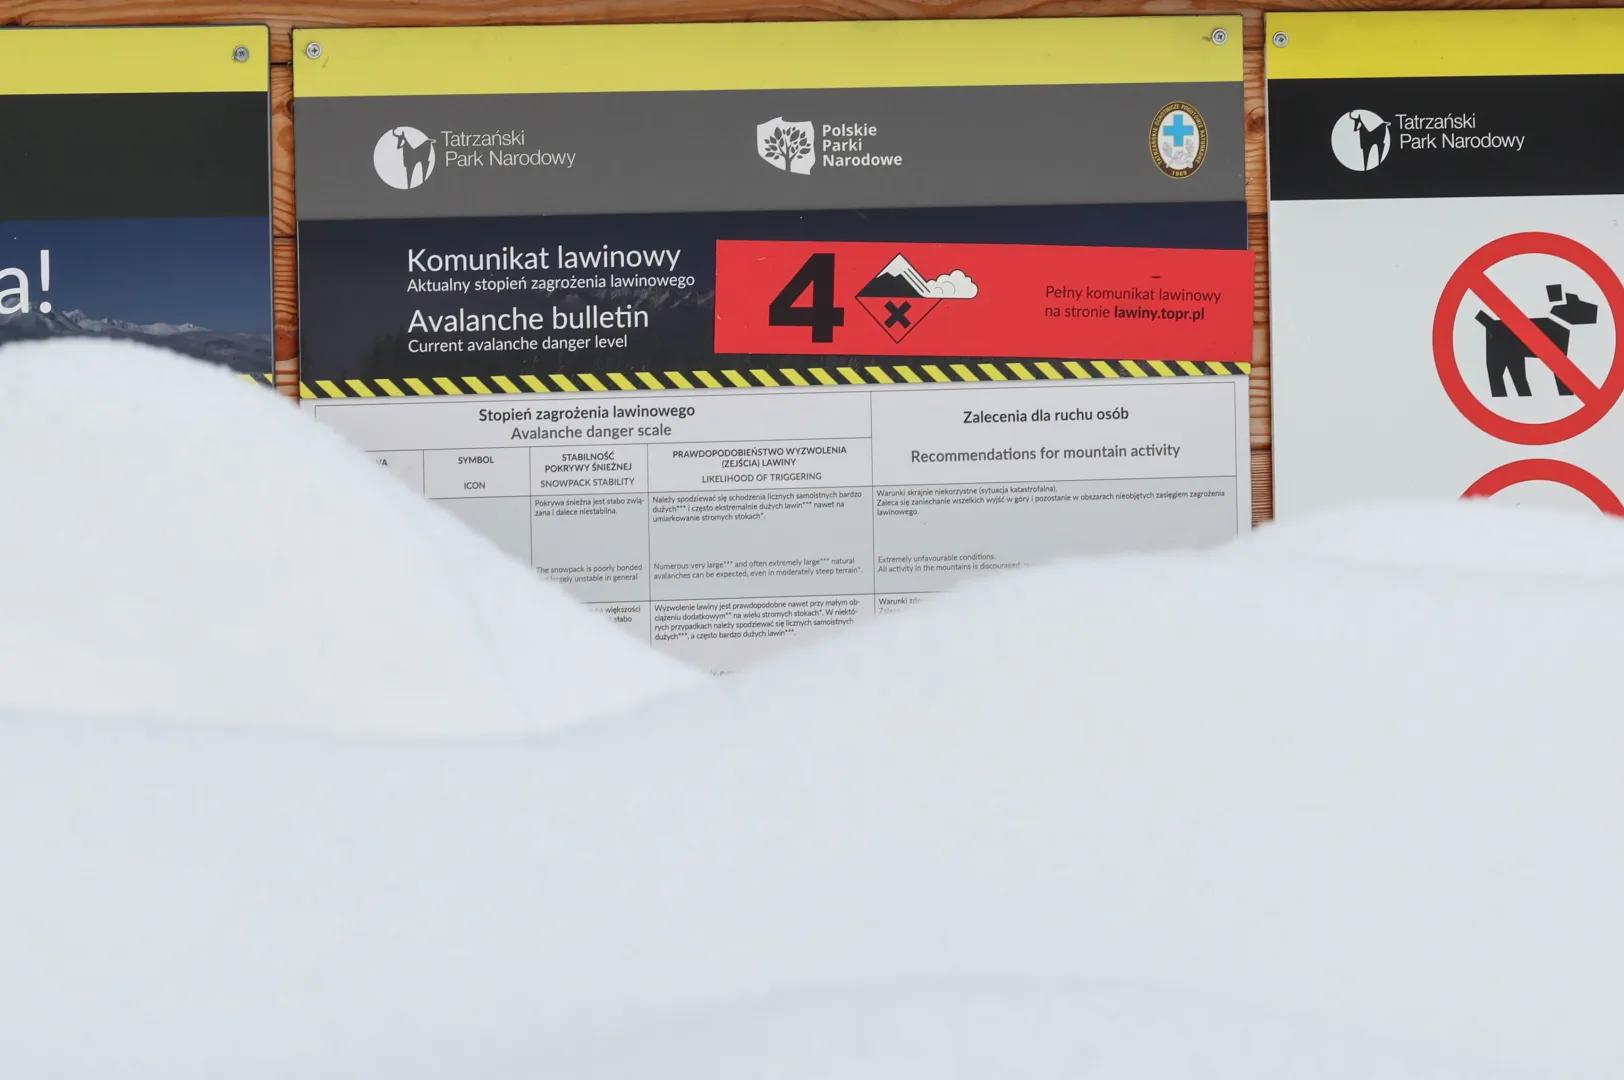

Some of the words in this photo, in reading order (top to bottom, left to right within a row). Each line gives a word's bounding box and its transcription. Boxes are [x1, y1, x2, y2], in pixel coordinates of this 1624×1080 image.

[1394, 113, 1475, 130] Tatrzański
[822, 124, 877, 136] Polskie
[440, 129, 524, 146] Tatrzański
[1400, 133, 1437, 149] Park
[1442, 132, 1525, 149] Narodowy
[822, 138, 862, 151] Parki
[445, 150, 483, 166] Park
[489, 149, 576, 167] Narodowy
[823, 153, 902, 166] Narodowe
[408, 246, 549, 272] Komunikat
[558, 244, 680, 271] lawinowy
[406, 277, 470, 293] Aktualny
[474, 276, 526, 292] stopień
[531, 275, 606, 292] zagrożenia
[610, 274, 695, 289] lawinowego
[768, 253, 844, 343] 4
[1046, 285, 1083, 301] Pełny
[1086, 286, 1155, 300] komunikat
[1159, 287, 1221, 304] lawinowy
[407, 306, 543, 333] Avalanche
[552, 304, 648, 329] bulletin
[1045, 307, 1060, 317] na
[1064, 305, 1110, 317] stronie
[1114, 305, 1204, 322] lawiny.topr.pl
[408, 339, 463, 352] Current
[467, 336, 538, 351] avalanche
[541, 336, 591, 351] danger
[595, 334, 627, 348] level
[479, 407, 531, 423] Stopień
[535, 406, 608, 422] zagrożenia
[613, 405, 695, 418] lawinowego
[963, 409, 1027, 423] Zalecenia
[1031, 409, 1050, 421] dla
[1054, 408, 1092, 421] ruchu
[1096, 407, 1129, 420] osób
[510, 425, 582, 440] Avalanche
[586, 424, 634, 440] danger
[637, 423, 671, 436] scale
[561, 450, 614, 463] STABILNOŚĆ
[672, 446, 784, 458] PRAWDOPODOBIEŃSTWO
[785, 446, 847, 455] WYZWOLENIA
[911, 447, 1036, 462] Recommendations
[1039, 446, 1060, 459] for
[1063, 445, 1126, 458] mountain
[1130, 444, 1180, 458] activity
[458, 455, 494, 464] SYMBOL
[721, 458, 760, 468] (ZEJŚCIA)
[761, 458, 796, 466] LAWINY
[544, 464, 590, 472] POKRYWY
[591, 461, 631, 471] ŚNIEŻNEJ
[540, 478, 591, 488] SNOWPACK
[592, 477, 634, 486] STABILITY
[702, 474, 754, 483] LIKELIHOOD
[755, 473, 768, 481] OF
[769, 472, 821, 481] TRIGGERING
[463, 481, 485, 489] ICON
[907, 488, 933, 497] skrajnie
[978, 486, 1008, 494] (sytuacja
[592, 498, 605, 507] jest
[652, 495, 675, 504] Należy
[676, 494, 716, 503] spodziewać
[717, 494, 727, 502] się
[767, 492, 794, 500] licznych
[795, 491, 837, 499] samoistnych
[900, 498, 910, 507] się
[911, 497, 950, 505] zaniechanie
[985, 496, 1005, 504] wyjść
[1014, 495, 1029, 504] góry
[1034, 494, 1071, 502] pozostanie
[1115, 492, 1154, 500] nieobjętych
[1155, 491, 1188, 499] zasięgiem
[1189, 490, 1225, 498] zagrożenia
[691, 504, 713, 513] często
[714, 503, 757, 511] ekstremalnie
[758, 502, 783, 510] dużych
[701, 513, 733, 521] stromych
[550, 565, 584, 574] snowpack
[593, 564, 615, 573] poorly
[768, 559, 802, 567] extremely
[612, 573, 638, 582] general
[715, 569, 750, 578] expected,
[775, 568, 814, 576] moderately
[654, 603, 695, 612] Wyzwolenie
[696, 603, 718, 611] lawiny
[718, 603, 731, 611] jest
[732, 601, 786, 610] prawdopodobne
[809, 601, 824, 609] przy
[825, 600, 848, 609] małym
[654, 613, 681, 622] ciążeniu
[761, 610, 792, 618] stromych
[654, 623, 669, 632] rych
[670, 622, 712, 631] przypadkach
[713, 621, 734, 629] należy
[735, 620, 774, 629] spodziewać
[775, 620, 784, 628] się
[785, 619, 812, 627] licznych
[696, 632, 717, 640] często
